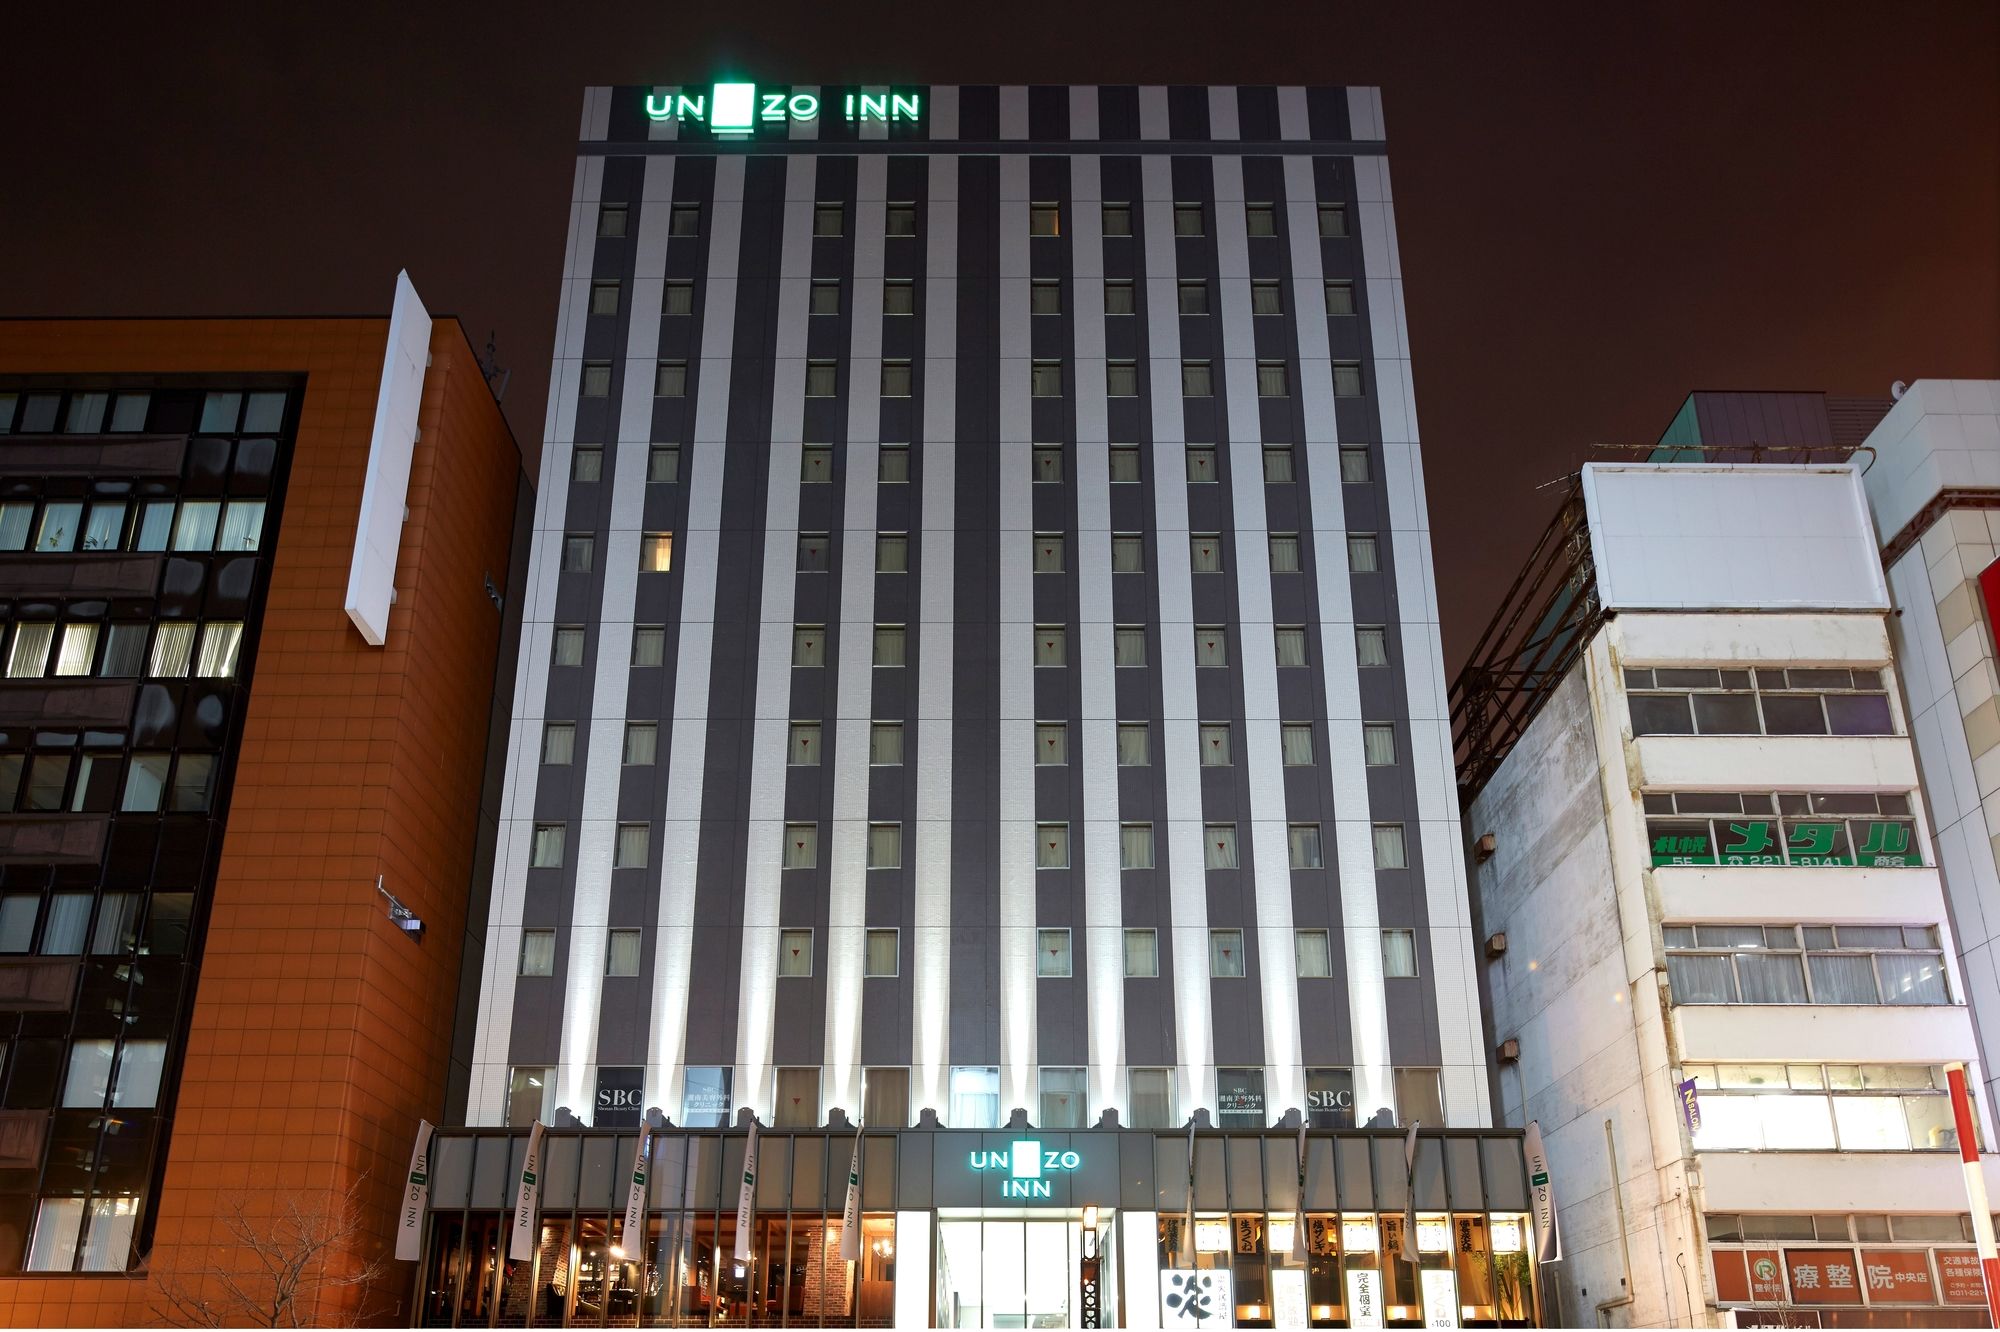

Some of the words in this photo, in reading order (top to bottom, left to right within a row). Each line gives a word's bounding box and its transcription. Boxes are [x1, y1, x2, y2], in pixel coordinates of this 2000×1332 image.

[646, 85, 818, 123] UNZO
[846, 94, 920, 118] INN
[1653, 836, 1708, 854] 札幌
[1725, 822, 1911, 854] メダル
[1749, 855, 1842, 867] 221-8141
[598, 1089, 642, 1106] SBC
[1307, 1090, 1352, 1107] SBC
[969, 1145, 1081, 1173] UNZO
[1003, 1180, 1051, 1198] INN
[1533, 1155, 1548, 1202] UNIZO
[406, 1206, 417, 1228] INN
[520, 1206, 529, 1228] INN
[629, 1206, 638, 1228] INN
[1540, 1207, 1550, 1229] INN
[1240, 1219, 1253, 1252] 生つくね
[1894, 1272, 1928, 1283] 中央店
[1356, 1272, 1372, 1317] 完全個室
